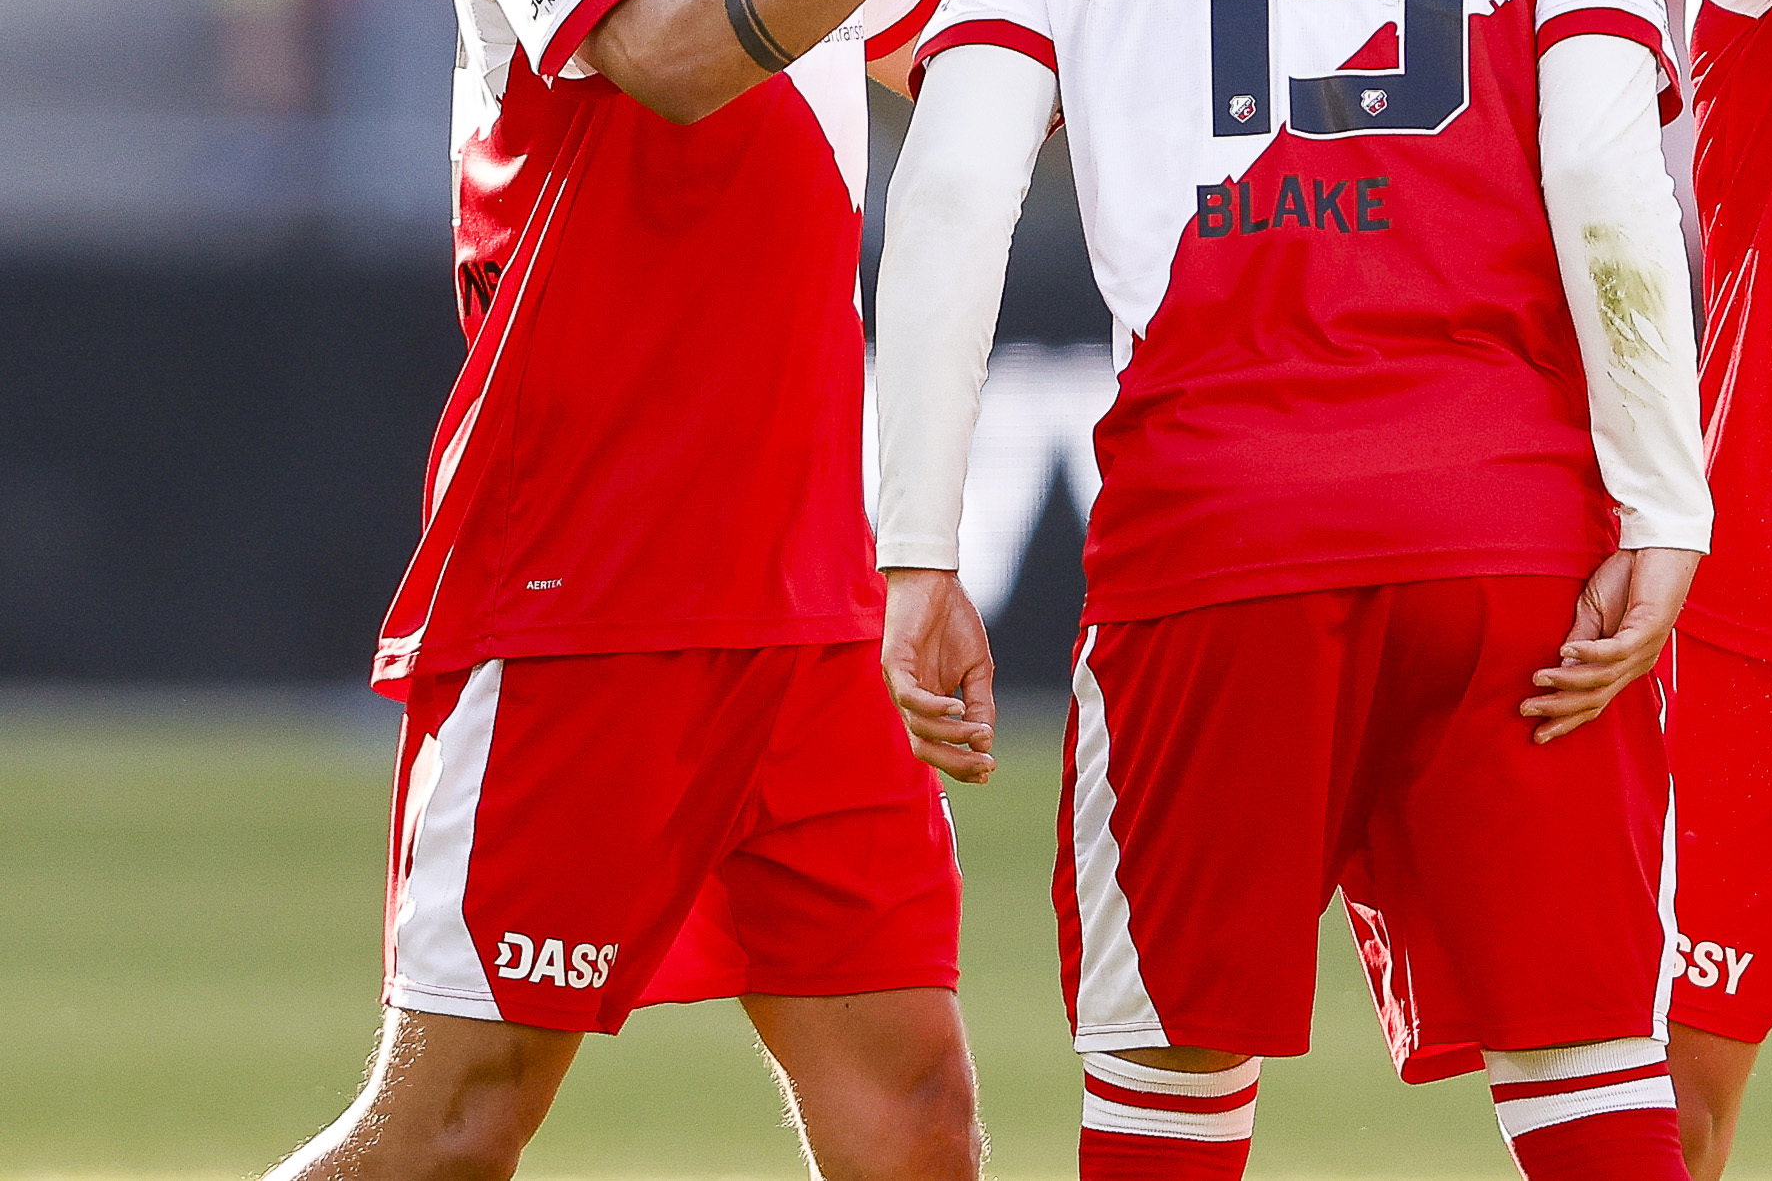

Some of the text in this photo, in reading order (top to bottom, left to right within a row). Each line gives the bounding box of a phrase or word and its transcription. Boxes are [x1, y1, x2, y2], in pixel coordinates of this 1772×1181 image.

[1196, 174, 1391, 239] BLAKE
[526, 577, 563, 590] AERTEK
[493, 930, 619, 989] DASS
